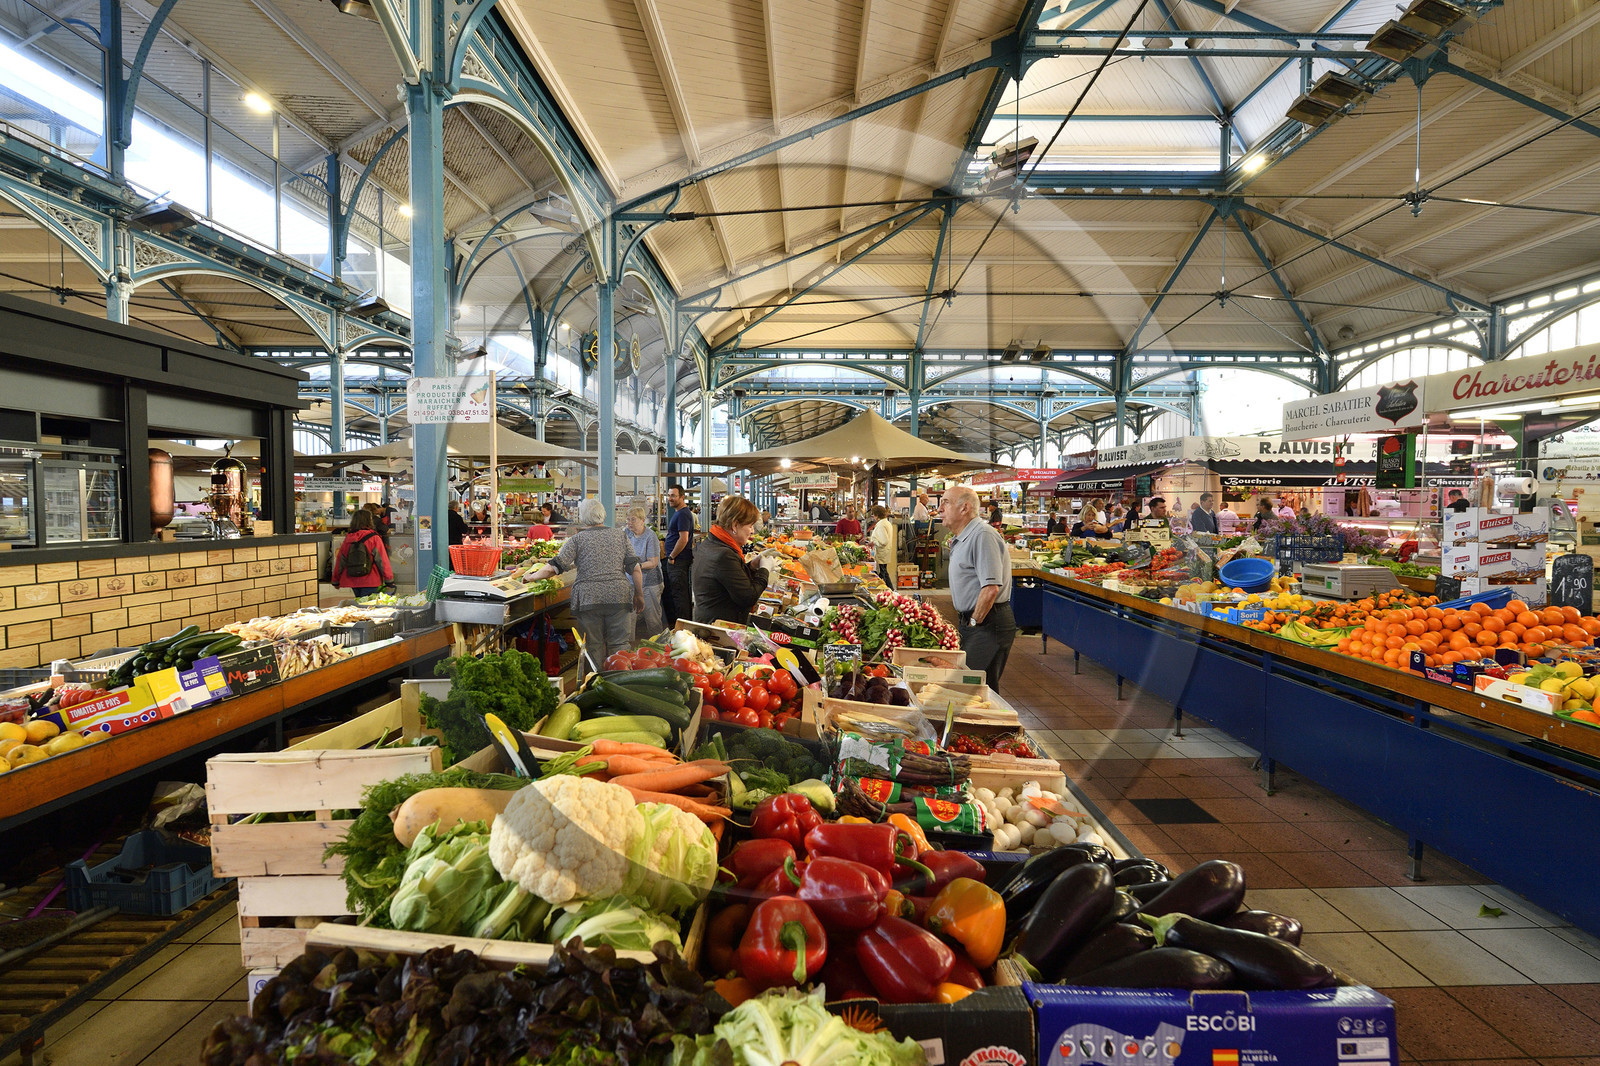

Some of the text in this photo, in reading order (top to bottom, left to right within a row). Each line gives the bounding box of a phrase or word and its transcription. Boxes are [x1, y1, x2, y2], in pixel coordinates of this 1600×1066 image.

[1286, 402, 1320, 420] MARCEL
[1323, 396, 1372, 415] SABATIER
[1285, 421, 1318, 432] Boucherie
[1326, 414, 1370, 427] Charcuterie
[1224, 478, 1281, 486] Boucherie
[1322, 477, 1376, 486] ALVISE
[1480, 517, 1511, 529] Lluiset
[1480, 552, 1510, 565] Lluiset
[771, 633, 792, 642] TROPS
[69, 696, 121, 719] TOMATES DE PAYS
